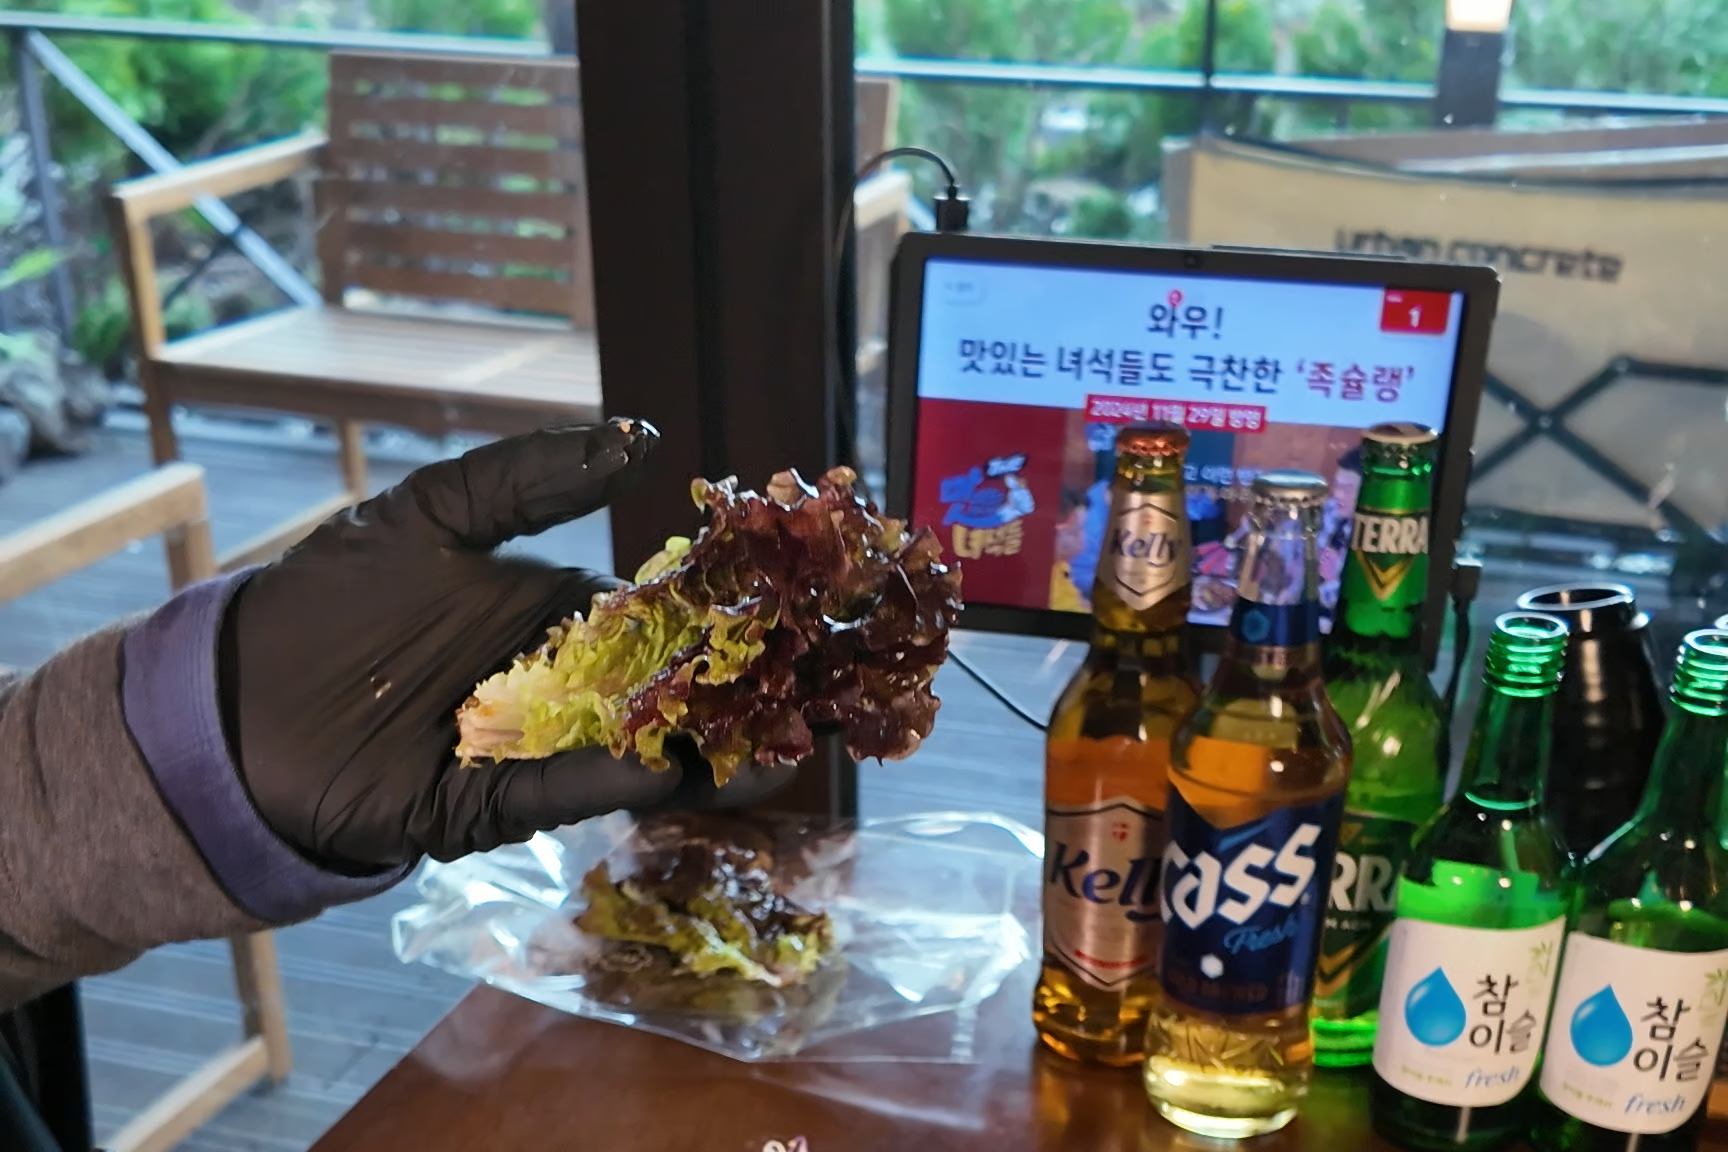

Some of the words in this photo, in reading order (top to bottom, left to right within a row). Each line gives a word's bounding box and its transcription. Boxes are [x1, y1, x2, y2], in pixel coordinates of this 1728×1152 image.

[1147, 302, 1224, 339] 와우!
[1409, 305, 1422, 328] 1
[960, 338, 1046, 379] 맛있는
[1057, 345, 1176, 387] 녀석들도
[1188, 353, 1282, 396] 극찬한
[1109, 526, 1182, 569] Kelly
[1352, 513, 1430, 556] TERRA
[1473, 974, 1519, 1017] 참
[1469, 1009, 1537, 1056] 이슬
[1640, 996, 1692, 1042] 참
[1464, 1065, 1521, 1090] fresh
[1633, 1037, 1710, 1083] 이슬
[1624, 1093, 1687, 1116] fresh
